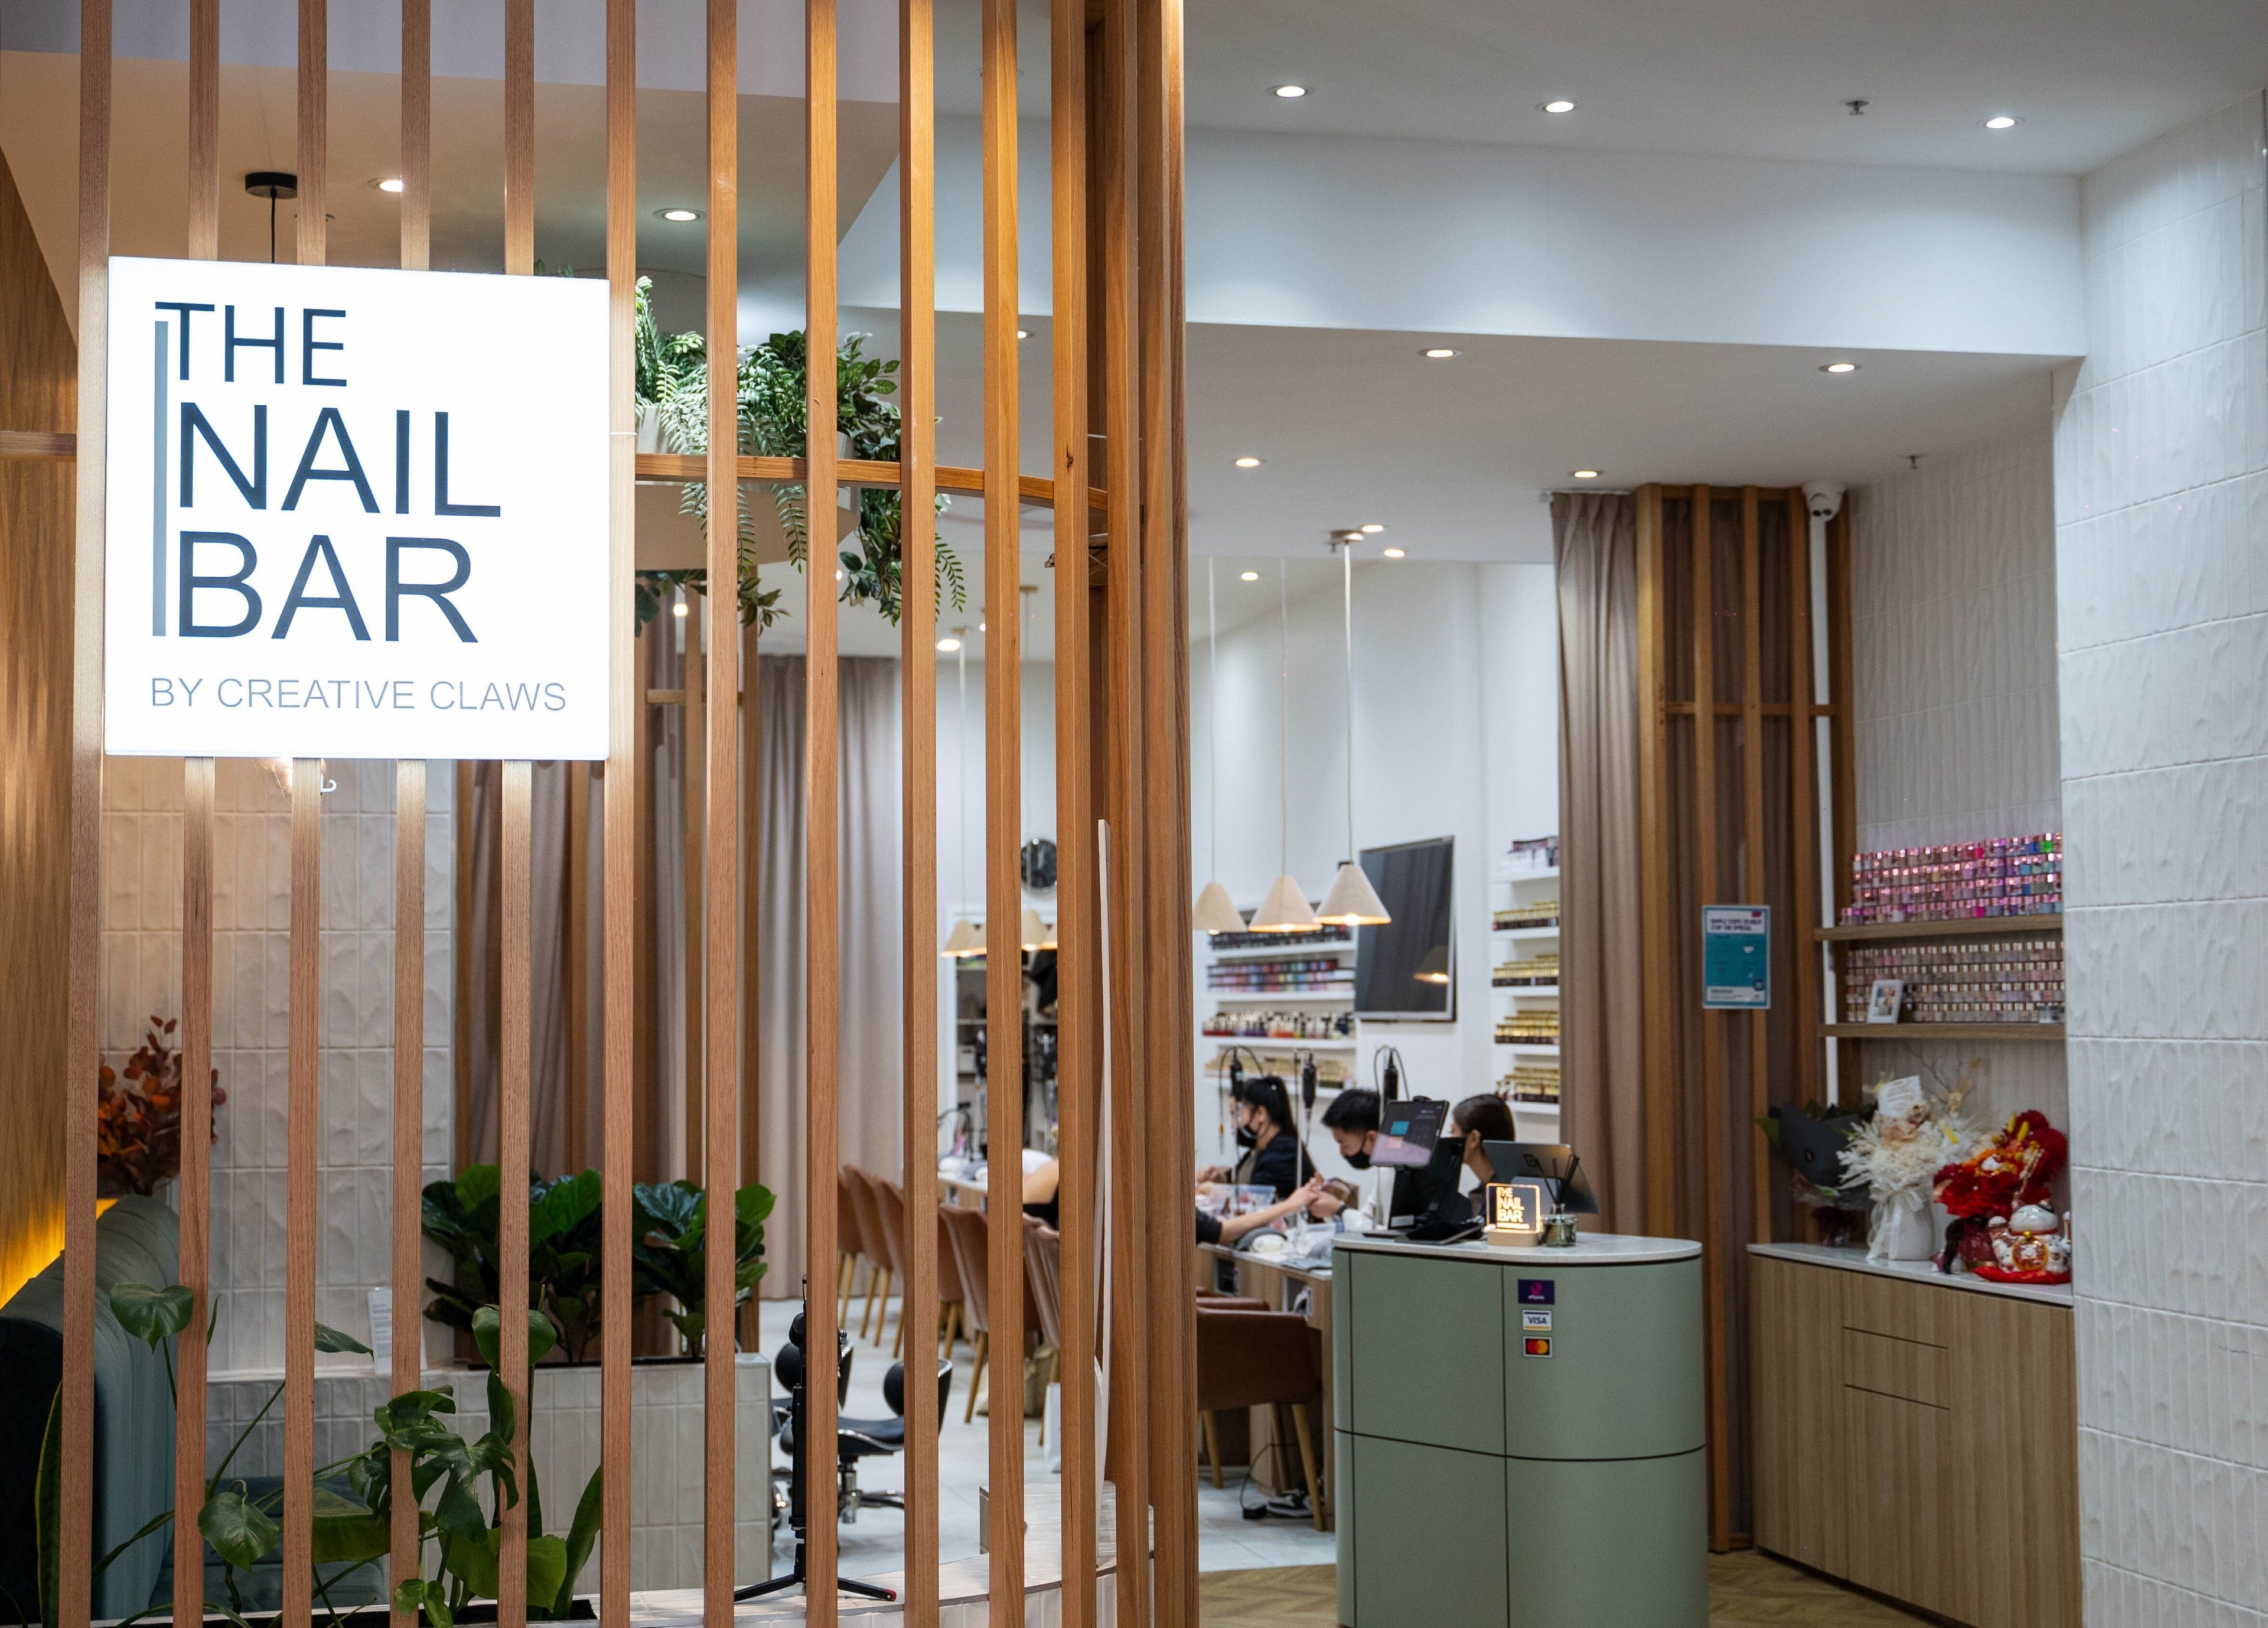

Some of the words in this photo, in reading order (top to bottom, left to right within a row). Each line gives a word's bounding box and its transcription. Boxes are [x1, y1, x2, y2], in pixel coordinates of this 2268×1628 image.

[155, 302, 347, 387] THE
[180, 402, 501, 518] NAIL
[179, 531, 479, 643] BAR
[152, 678, 204, 708] BY
[218, 679, 415, 709] CREATIVE
[431, 681, 566, 711] CLAWS
[1497, 1187, 1513, 1197] THE
[1498, 1197, 1524, 1210] NAIL
[1498, 1209, 1523, 1222] BAR
